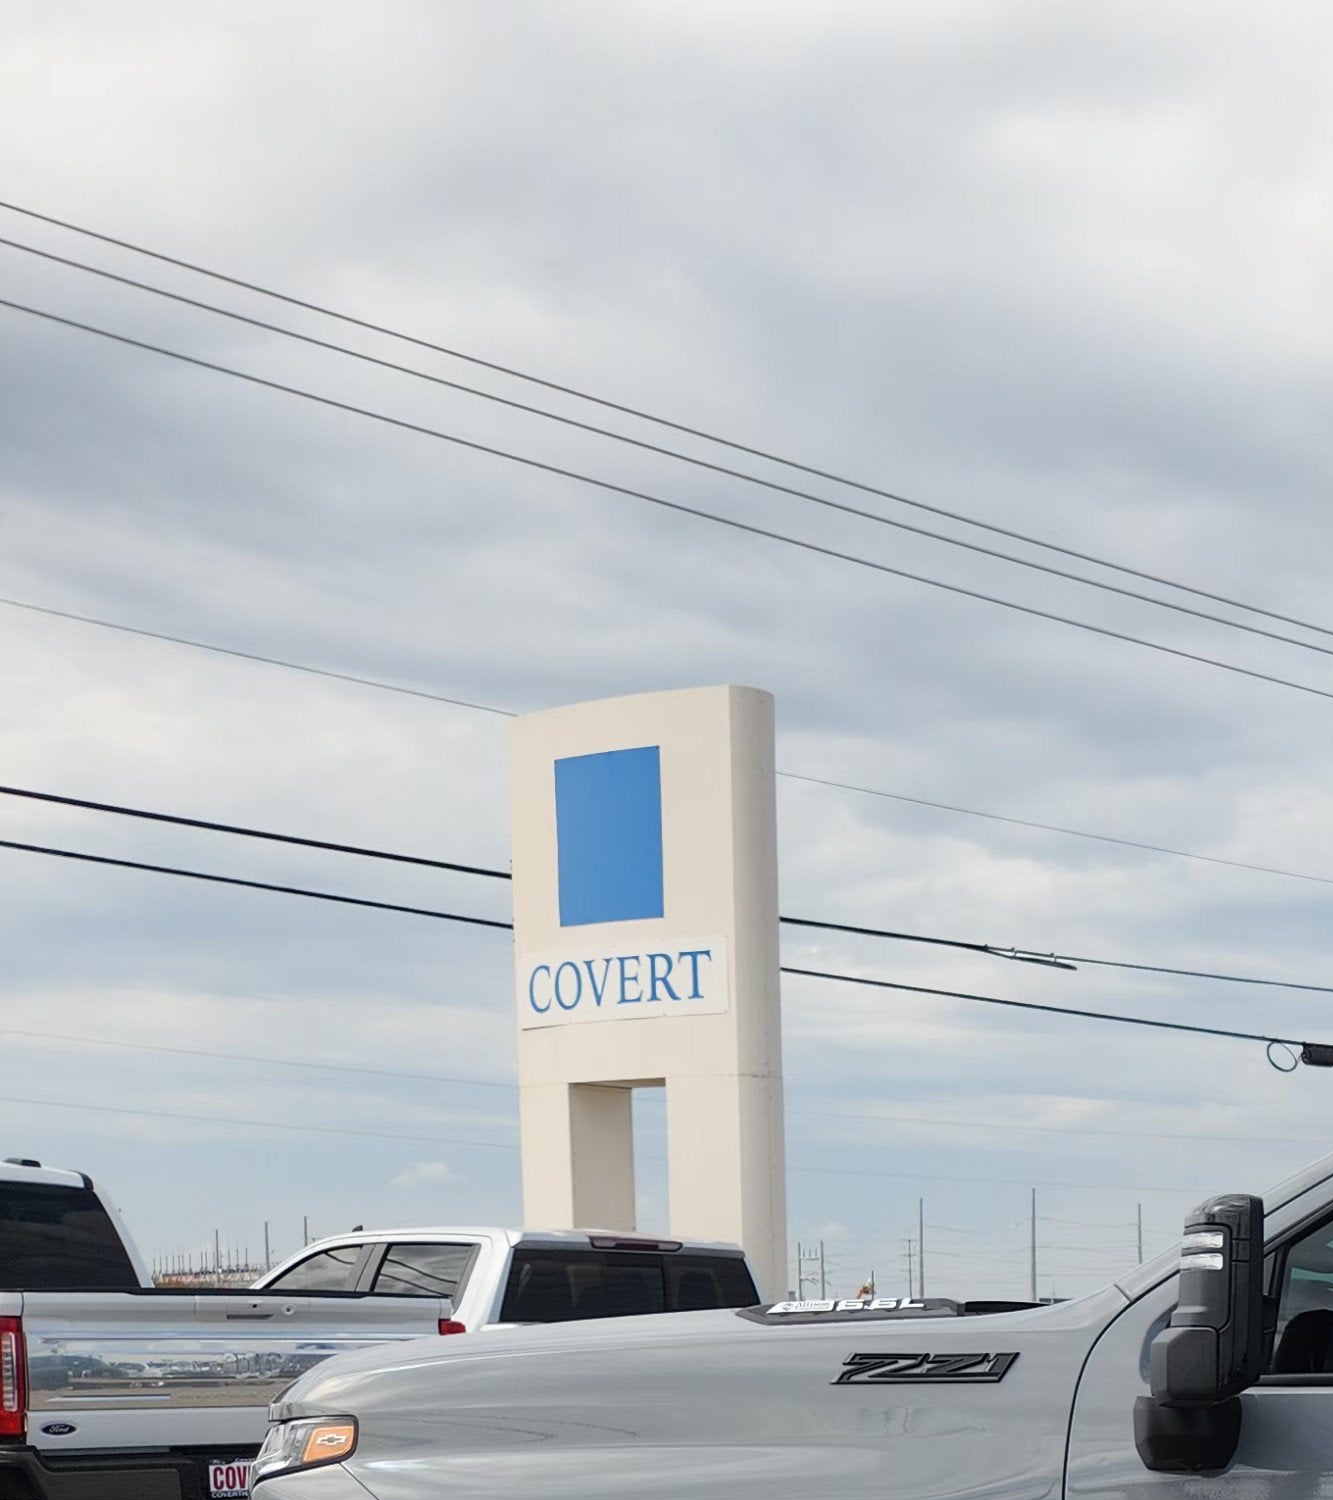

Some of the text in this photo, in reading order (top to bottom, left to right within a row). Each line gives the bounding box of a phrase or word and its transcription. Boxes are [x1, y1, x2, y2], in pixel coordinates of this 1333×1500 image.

[528, 949, 712, 1014] COVERT
[835, 1297, 925, 1312] 6.6L
[830, 1352, 1020, 1384] Z71
